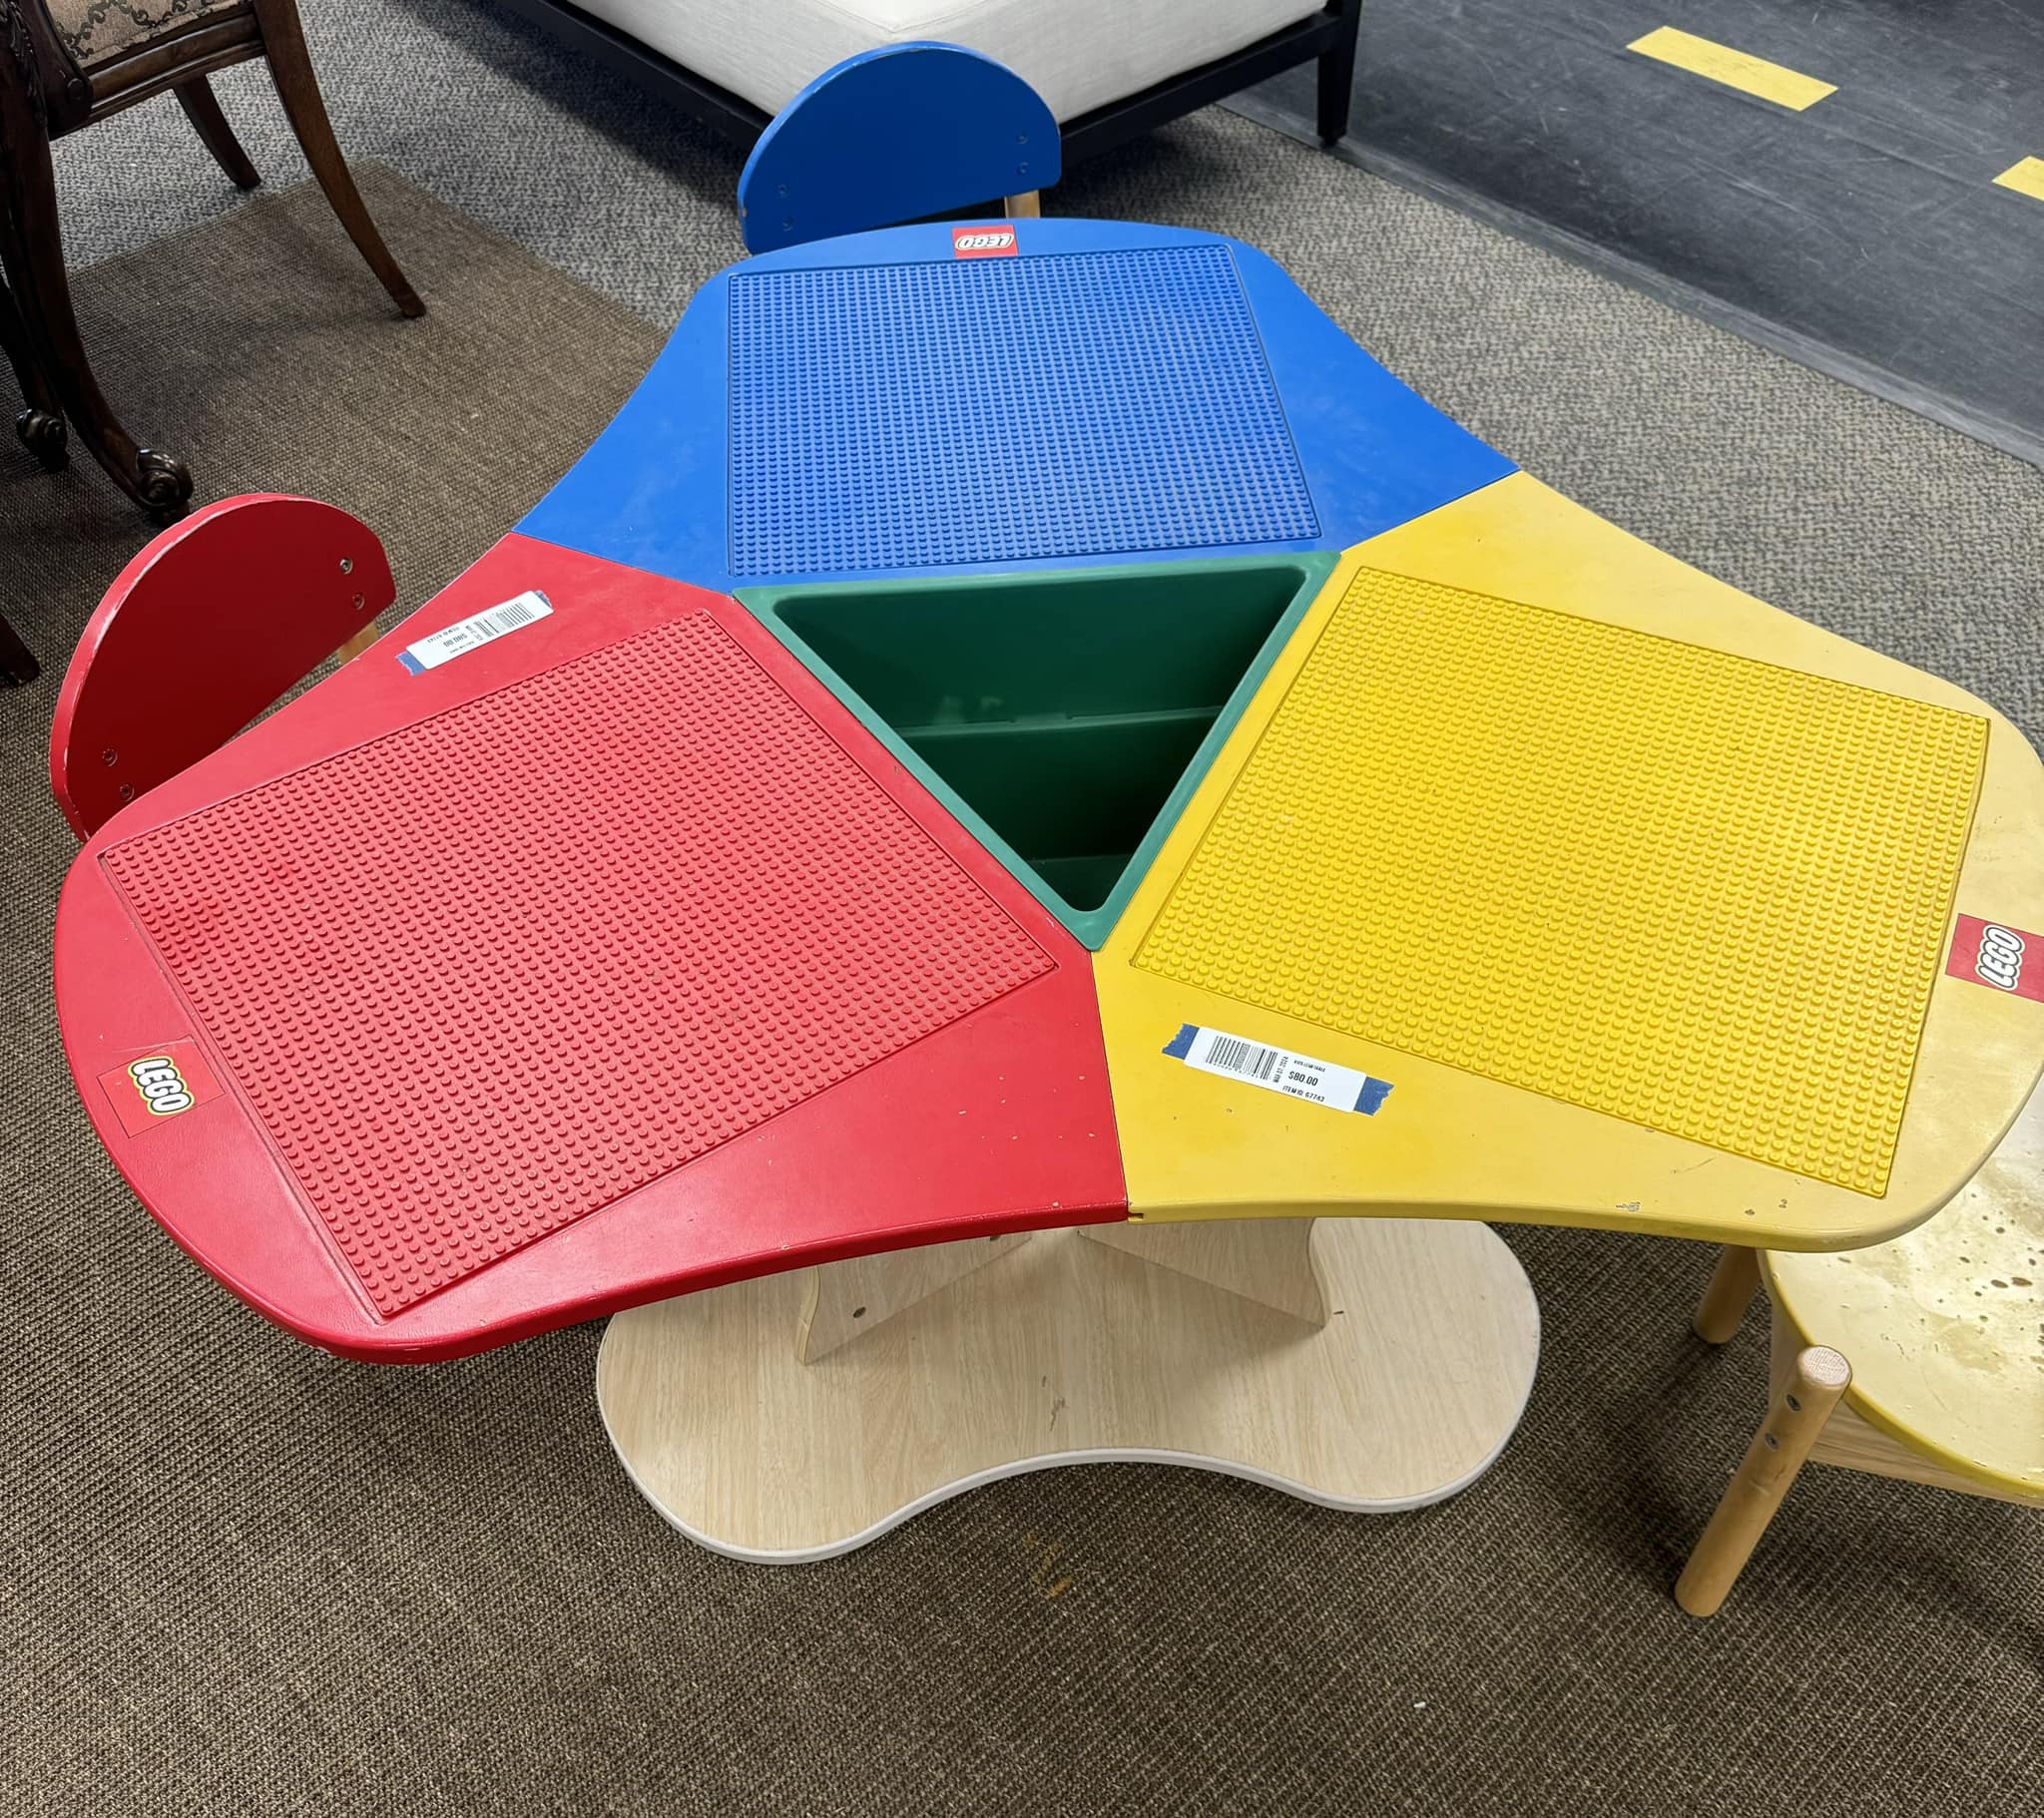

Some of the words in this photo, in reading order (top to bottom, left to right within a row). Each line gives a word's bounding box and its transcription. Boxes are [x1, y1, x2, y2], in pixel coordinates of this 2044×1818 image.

[957, 233, 1013, 249] LEGO
[1977, 926, 2024, 989] LEGO
[130, 1057, 193, 1114] LEGO
[1288, 1071, 1318, 1086] $80.00
[1282, 1085, 1296, 1094] ITEM
